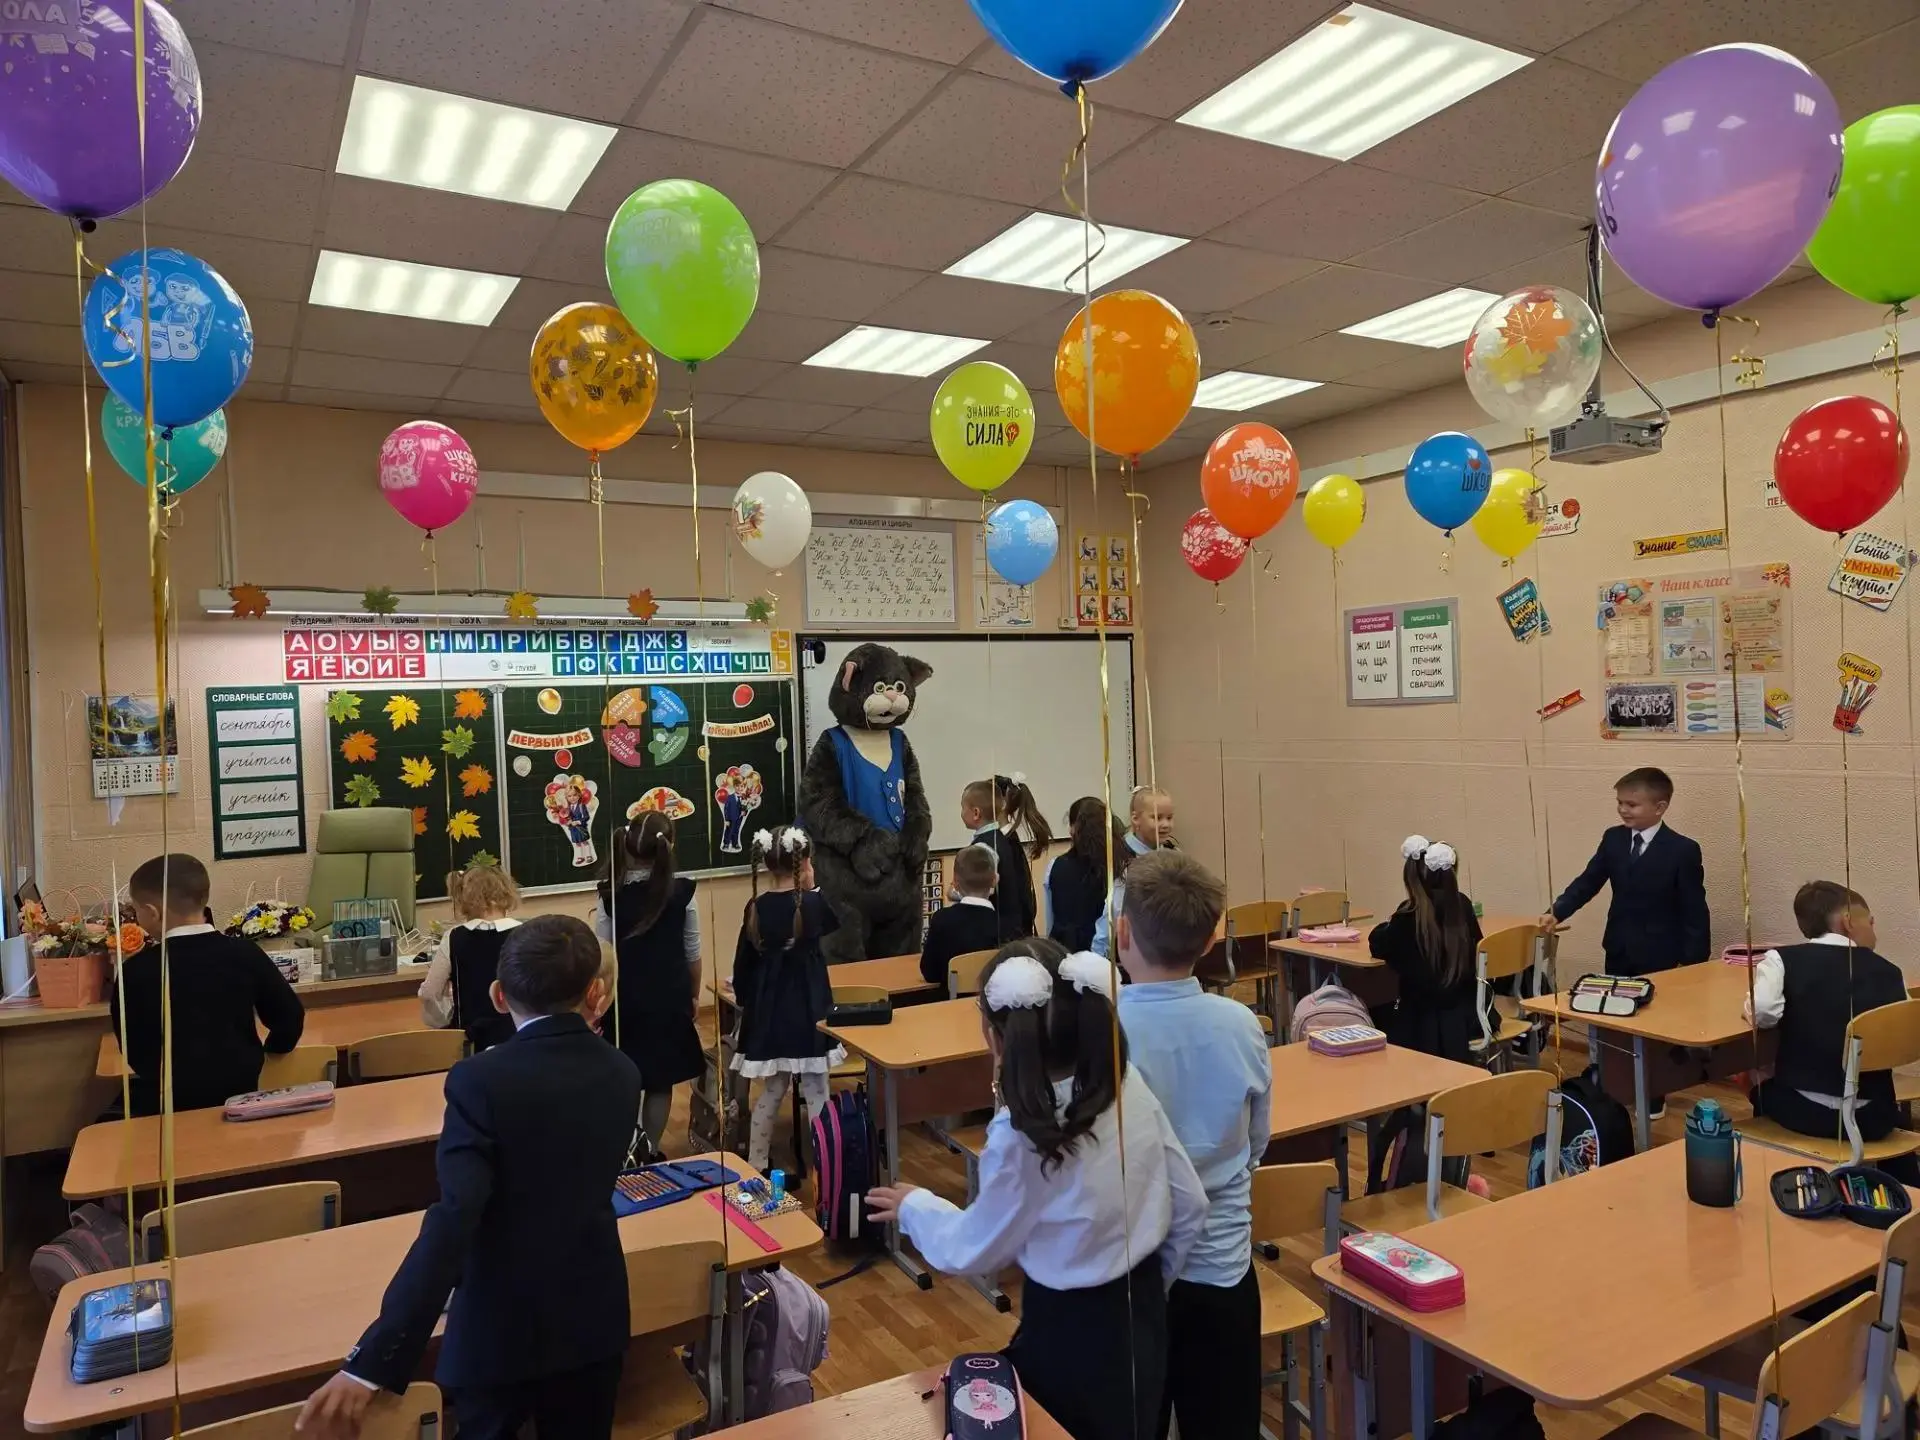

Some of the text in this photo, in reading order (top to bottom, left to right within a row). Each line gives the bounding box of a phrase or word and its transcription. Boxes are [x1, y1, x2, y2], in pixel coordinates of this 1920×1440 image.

[965, 421, 1004, 447] СИЛА
[1229, 464, 1290, 488] ШКОЛА
[1854, 540, 1891, 560] Быть
[1661, 577, 1731, 592] Наш класс
[290, 633, 309, 650] А
[318, 633, 337, 650] О
[349, 633, 365, 650] У
[372, 633, 394, 651] Ы
[403, 633, 420, 650] Э
[430, 633, 445, 650] Н
[455, 633, 470, 650] М
[481, 633, 497, 650] Л
[508, 633, 521, 650] Р
[532, 629, 546, 650] Й
[556, 633, 570, 650] Б
[580, 633, 593, 649] В
[602, 633, 614, 649] Г
[624, 633, 640, 651] Д
[646, 633, 664, 649] Ж
[671, 633, 683, 649] З
[1415, 632, 1438, 640] ТОЧКА
[1356, 640, 1390, 650] ЖИ ШИ
[1410, 644, 1442, 653] ПТЕНЧИК
[1357, 657, 1387, 666] ЧА ЩА
[1412, 656, 1440, 665] ПЕЧНИК
[292, 659, 310, 677] Я
[321, 656, 337, 676] Ё
[345, 658, 369, 676] Ю
[376, 658, 394, 676] И
[404, 657, 419, 675] Е
[556, 657, 570, 673] П
[578, 656, 596, 673] Ф
[605, 656, 617, 672] К
[627, 656, 640, 671] Т
[646, 656, 665, 672] Ш
[671, 656, 684, 672] С
[692, 656, 706, 671] Х
[714, 656, 727, 673] Ц
[735, 656, 747, 671] Ч
[752, 656, 770, 672] Щ
[776, 656, 787, 670] Ь
[1411, 669, 1442, 677] ГОНЩИК
[1357, 675, 1368, 683] ЧУ
[1410, 680, 1445, 689] СВАРЩИК
[212, 691, 294, 702] СЛОВАРНЫЕ СЛОВА
[512, 729, 591, 748] ПЕРВЫЙ РАЗ
